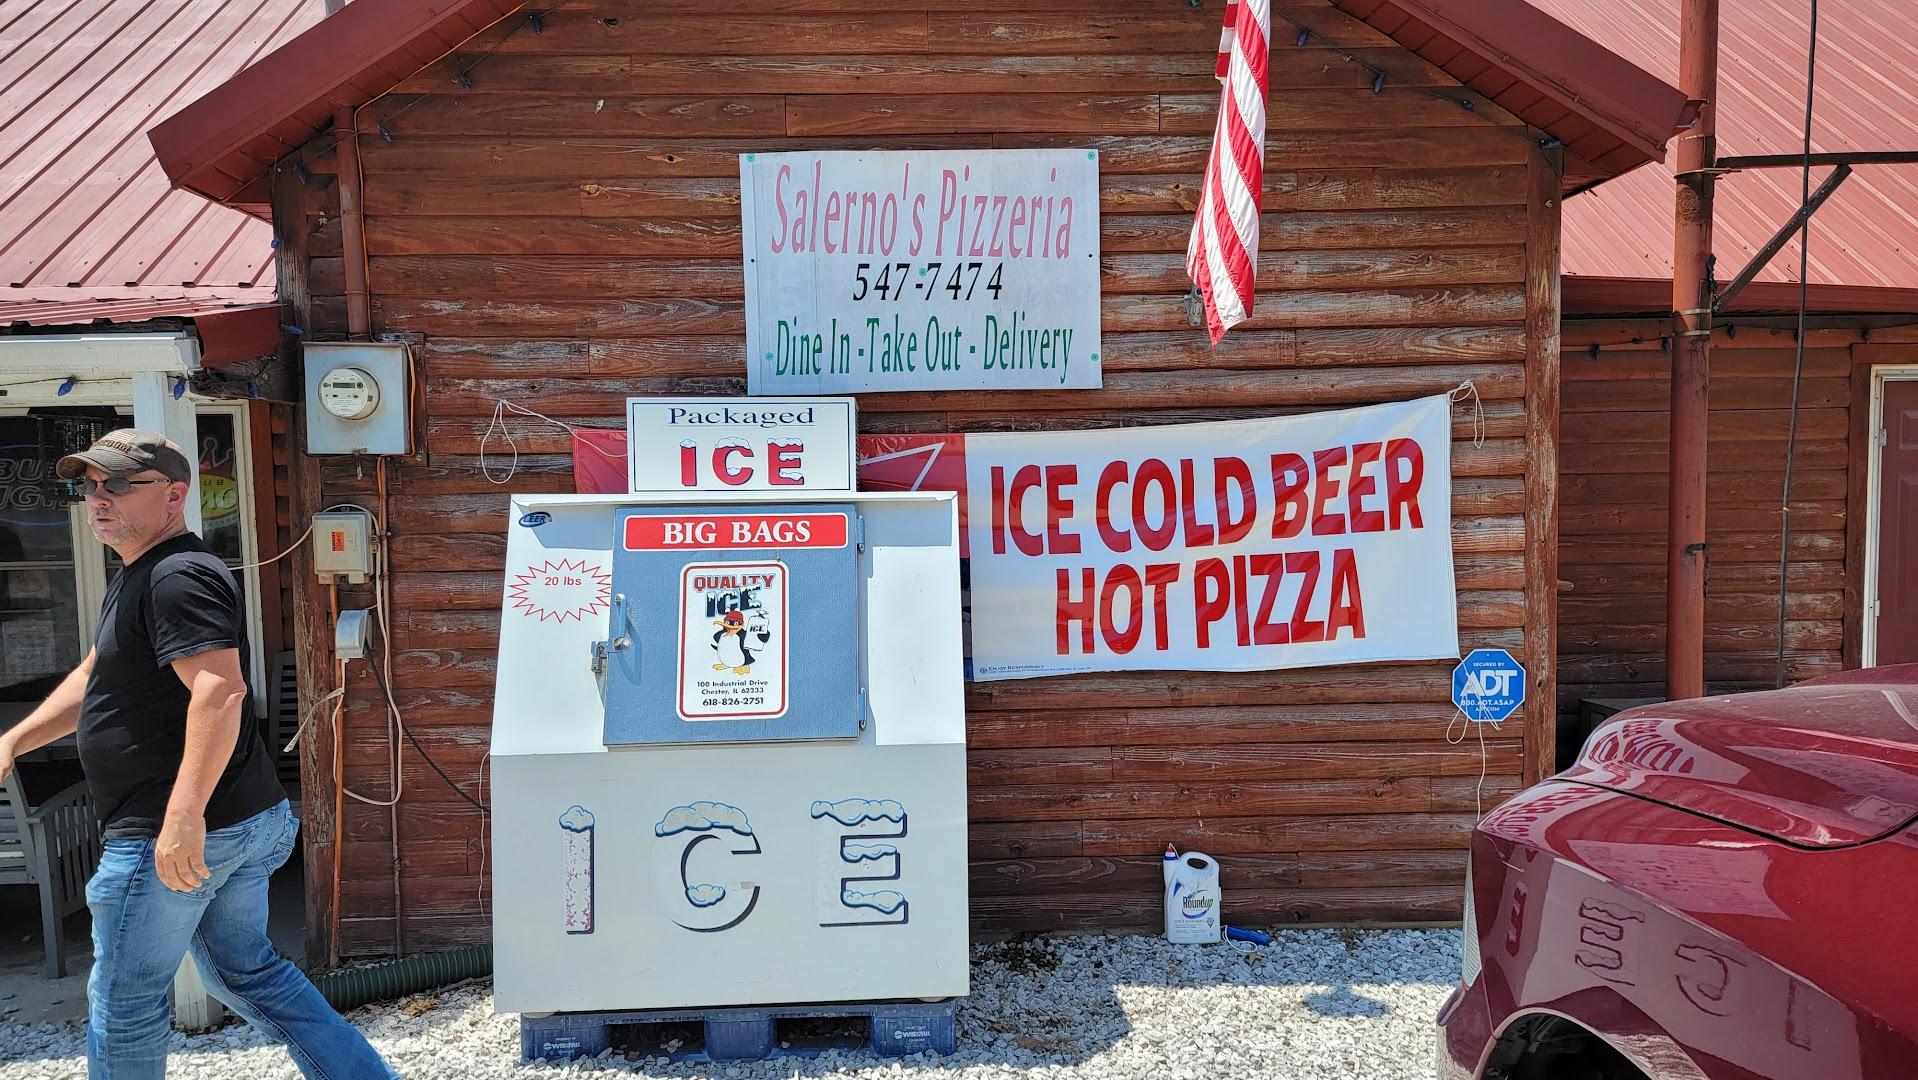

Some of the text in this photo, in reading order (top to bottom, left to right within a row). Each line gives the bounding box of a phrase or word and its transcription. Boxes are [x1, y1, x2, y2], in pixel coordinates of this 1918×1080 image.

[770, 159, 1073, 259] Salerno's Pizzeria
[852, 262, 1004, 301] 547-7474
[775, 315, 823, 376] Dine
[830, 318, 851, 374] In
[925, 315, 962, 372] Out
[983, 311, 1073, 384] Delivery
[668, 407, 815, 429] Packaged
[679, 436, 805, 487] ICE
[990, 437, 1425, 557] ICE COLD BEER
[662, 519, 811, 545] BIG BAGS
[544, 576, 582, 586] 20 lbs
[693, 573, 776, 592] QUALITY
[706, 585, 762, 618] ICE
[1056, 548, 1366, 655] HOT PIZZA
[1460, 669, 1518, 697] ADT
[702, 697, 764, 707] 618-826-2751
[559, 798, 909, 934] ICE
